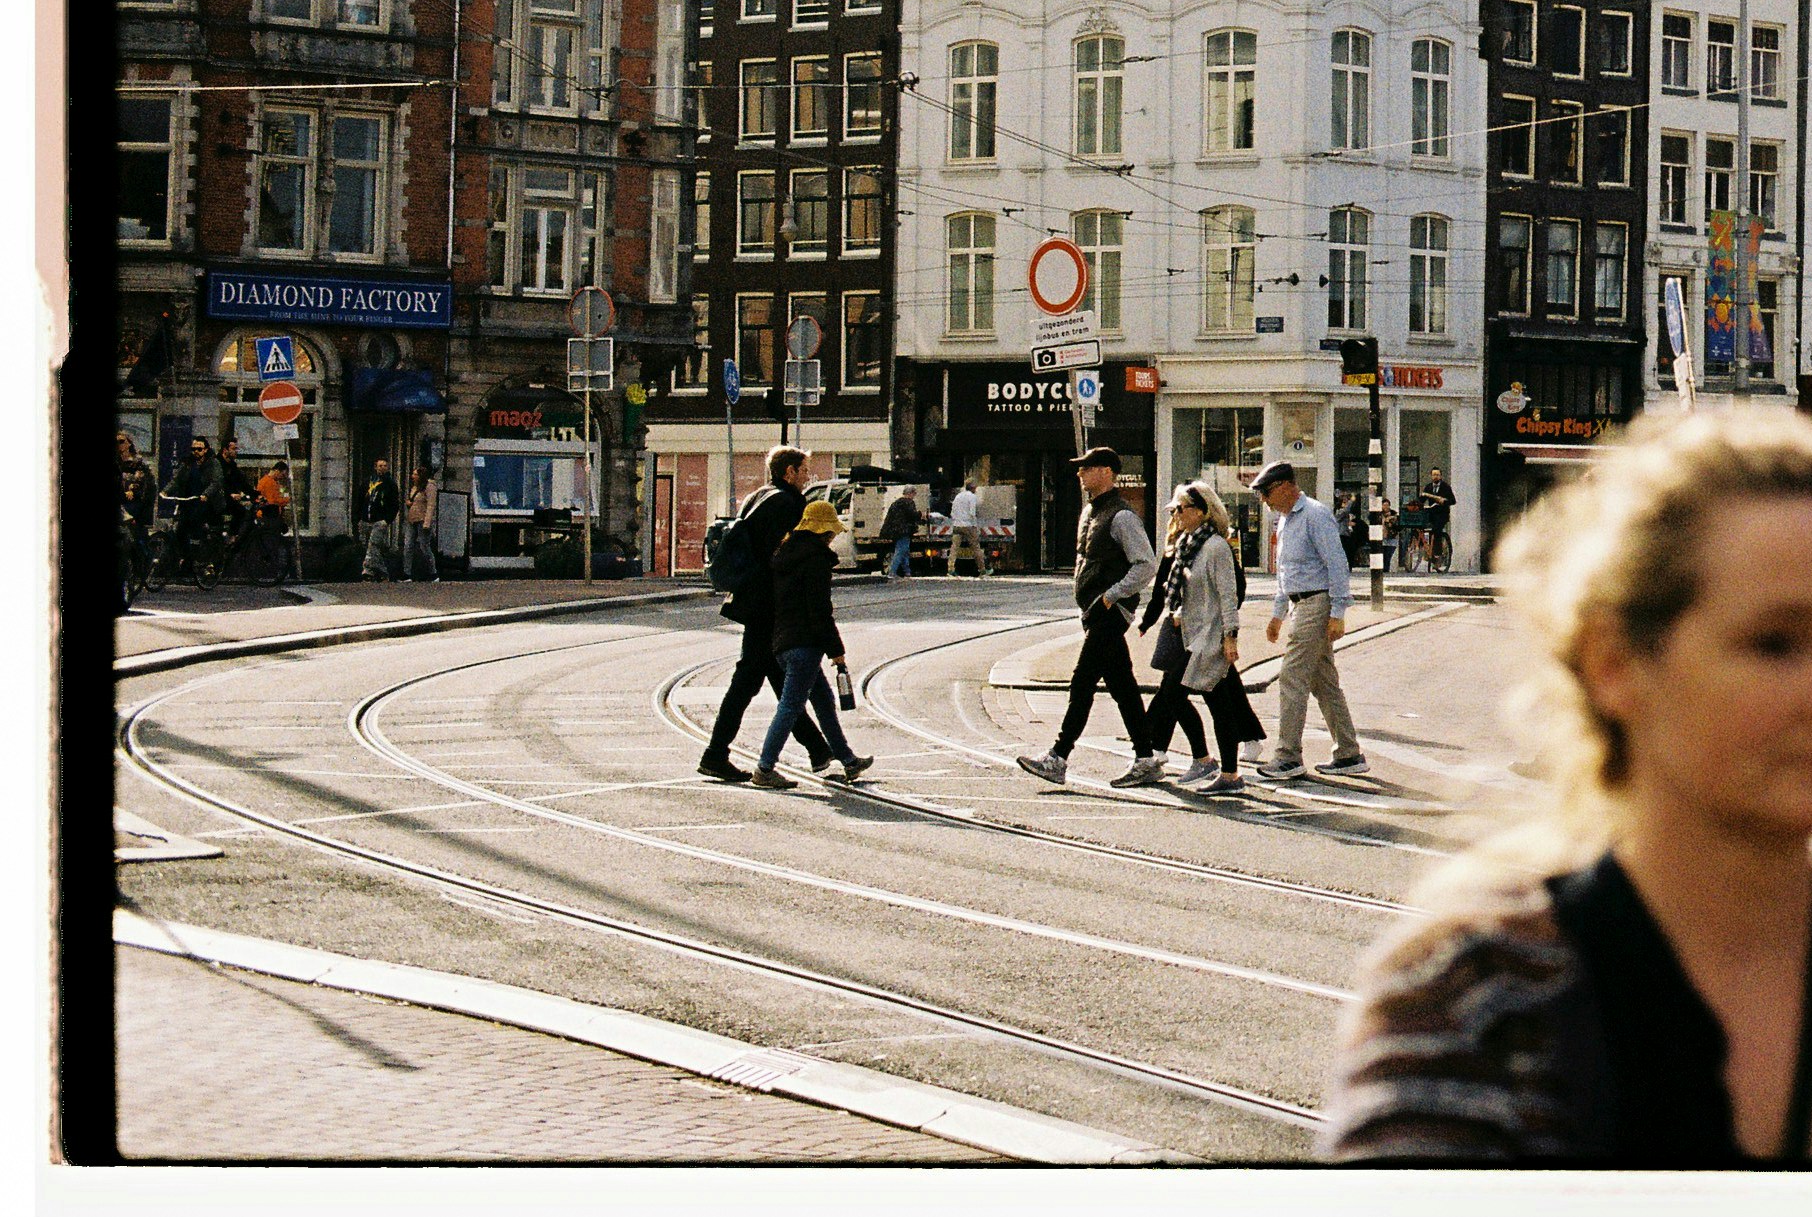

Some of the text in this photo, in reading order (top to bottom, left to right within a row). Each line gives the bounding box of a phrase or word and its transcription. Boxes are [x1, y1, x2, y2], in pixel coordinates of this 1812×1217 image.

[219, 282, 441, 313] DIAMOND FACTORY
[1039, 316, 1084, 330] uitgezonderd
[1036, 332, 1059, 342] lijnbus
[1072, 327, 1089, 335] tram
[987, 382, 1105, 400] BODYCT
[987, 403, 1104, 412] TATTOO & PIERG
[489, 410, 543, 427] maoz
[1516, 417, 1561, 437] Chipsy
[1563, 418, 1592, 438] King
